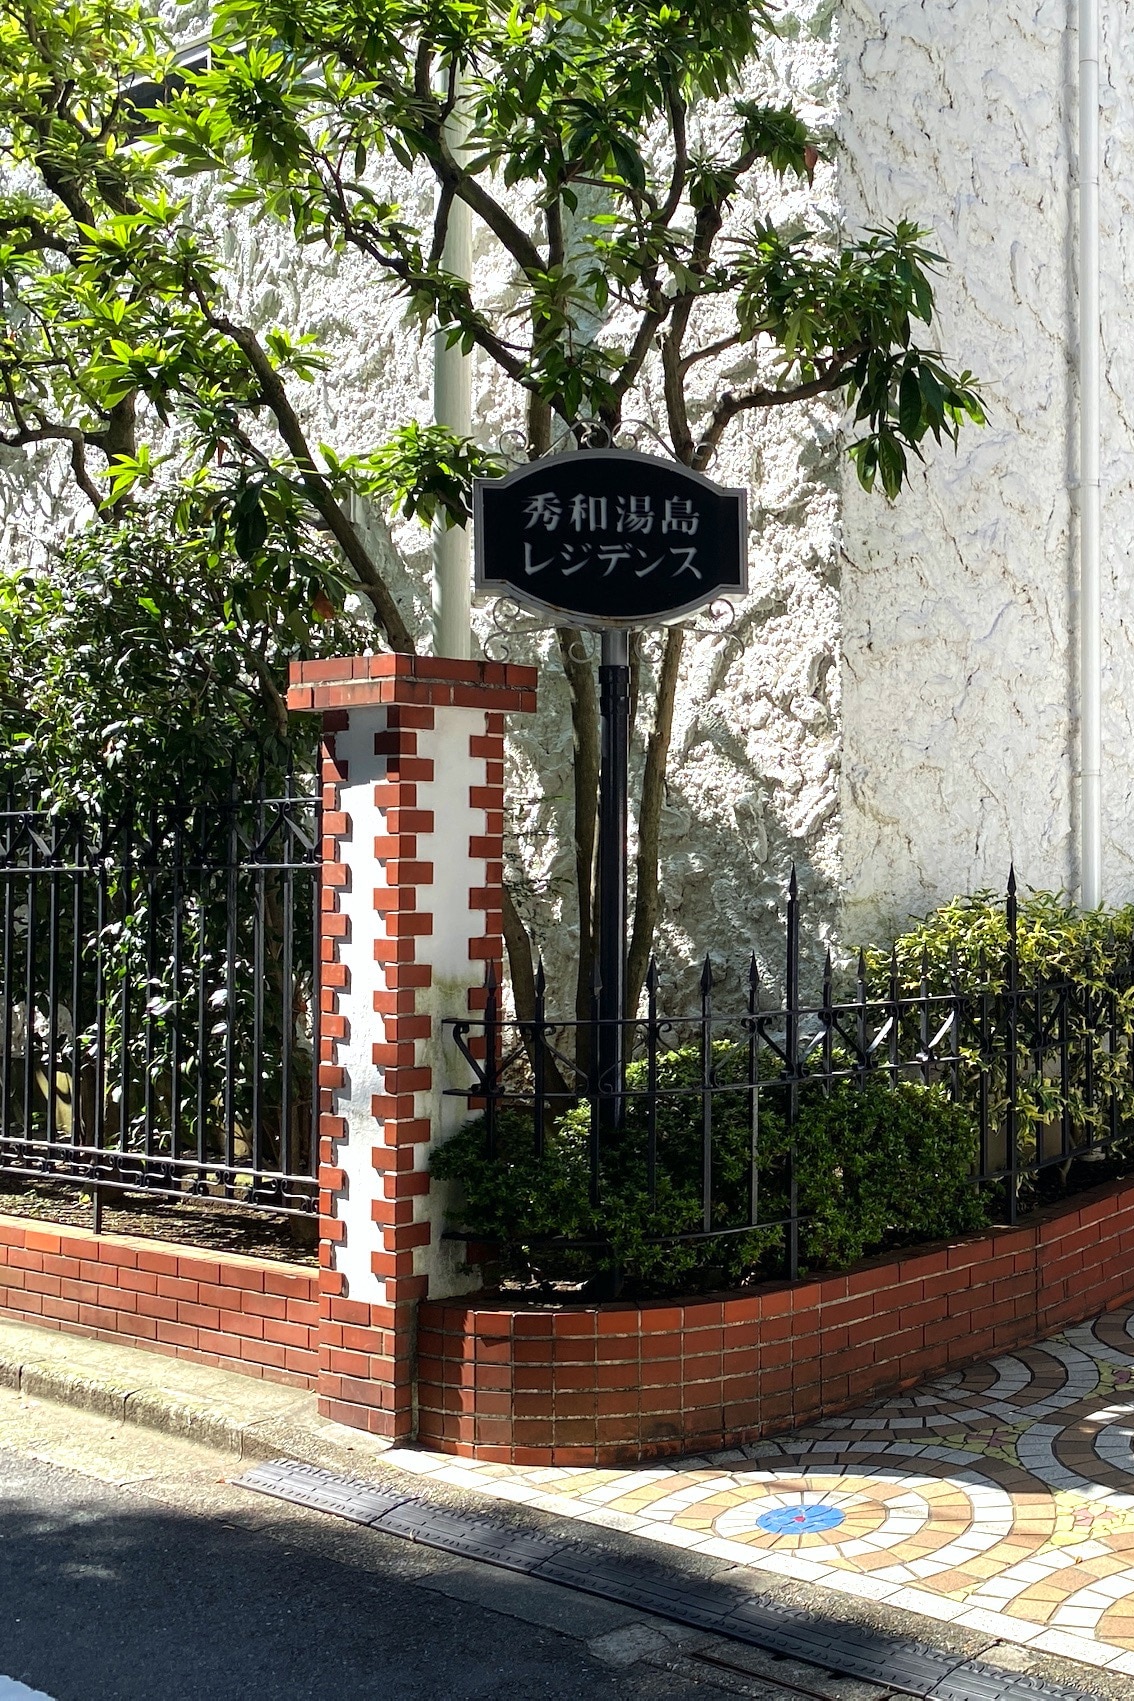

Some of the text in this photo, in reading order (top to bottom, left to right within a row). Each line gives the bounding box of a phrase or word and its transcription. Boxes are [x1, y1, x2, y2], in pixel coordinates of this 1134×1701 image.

[522, 491, 700, 535] 秀和湯島
[523, 541, 702, 580] レジデンス
